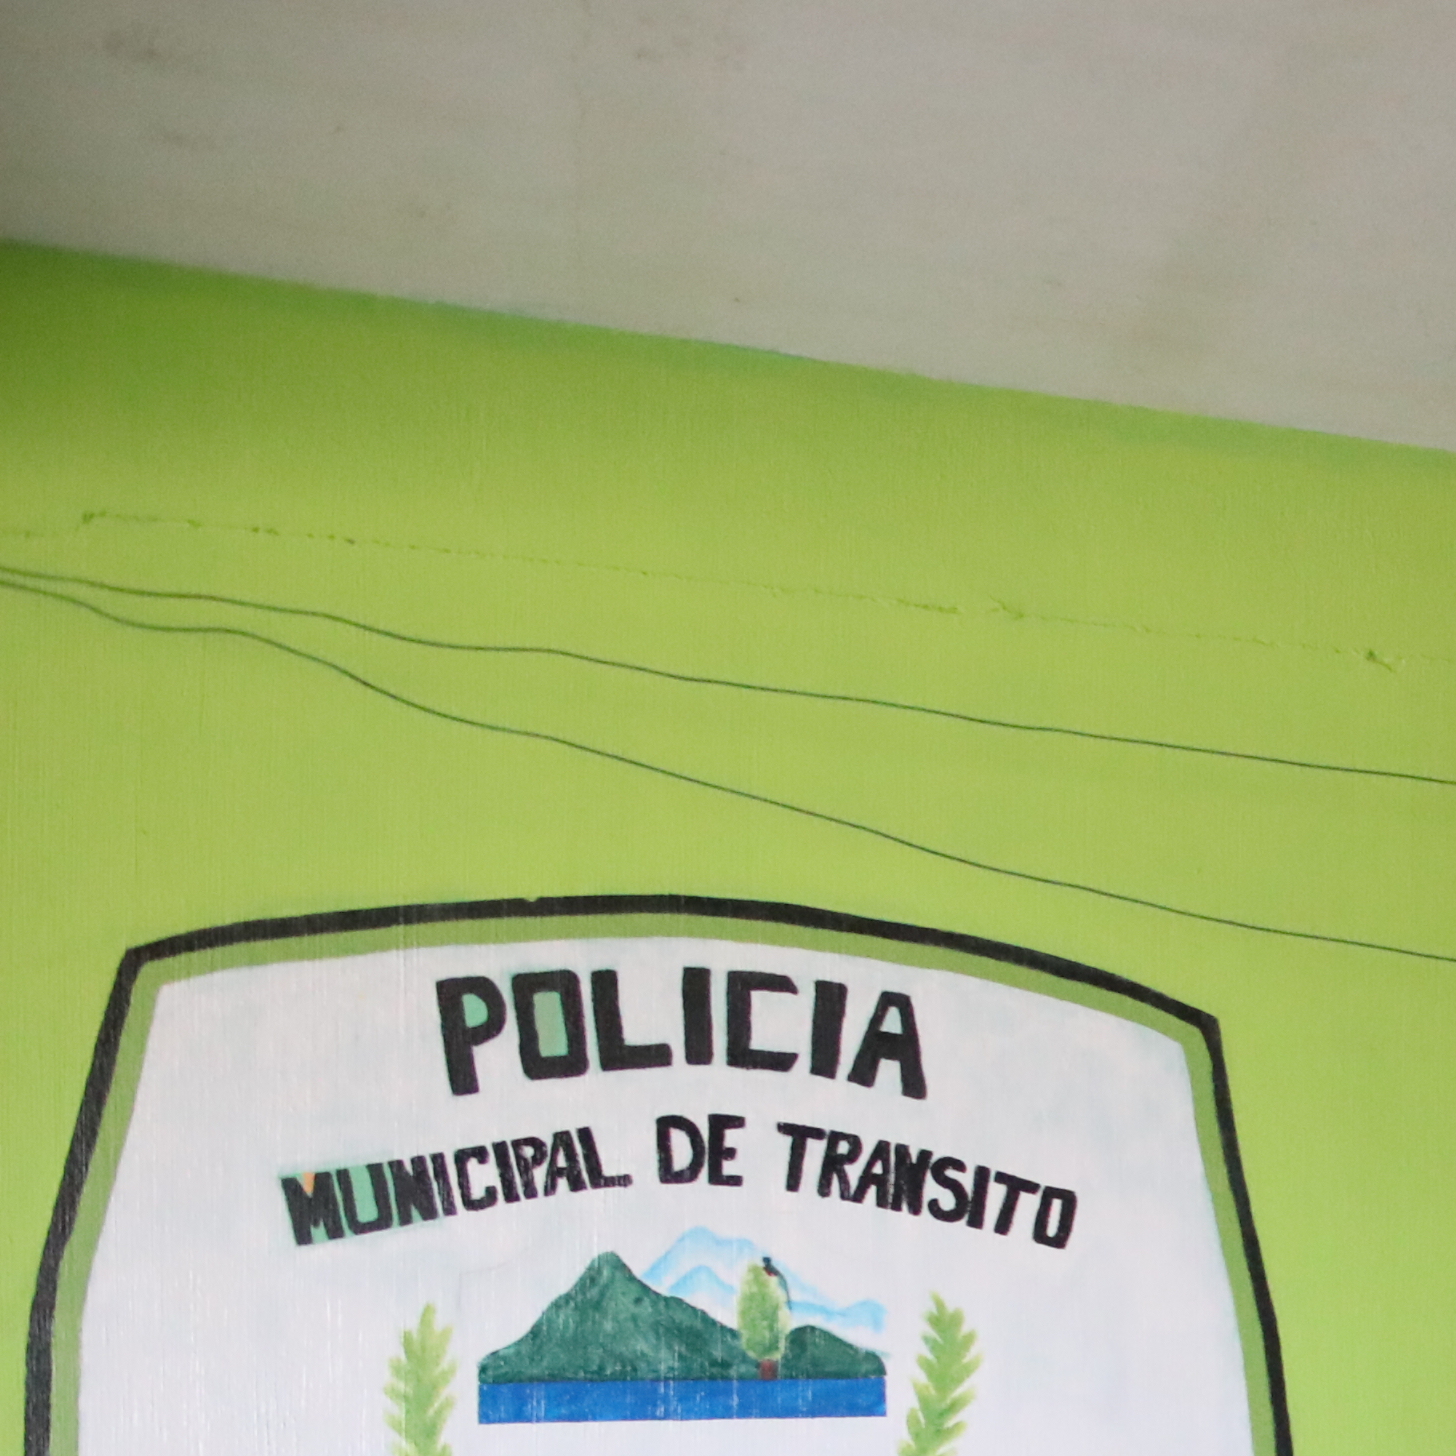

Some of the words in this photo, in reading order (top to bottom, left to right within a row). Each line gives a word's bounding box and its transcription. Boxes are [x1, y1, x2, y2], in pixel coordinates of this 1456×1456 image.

[435, 965, 928, 1100] POLICIA
[280, 1125, 633, 1247] MUNICIPAL
[654, 1113, 747, 1188] DE
[776, 1120, 1080, 1251] TRANSITO
